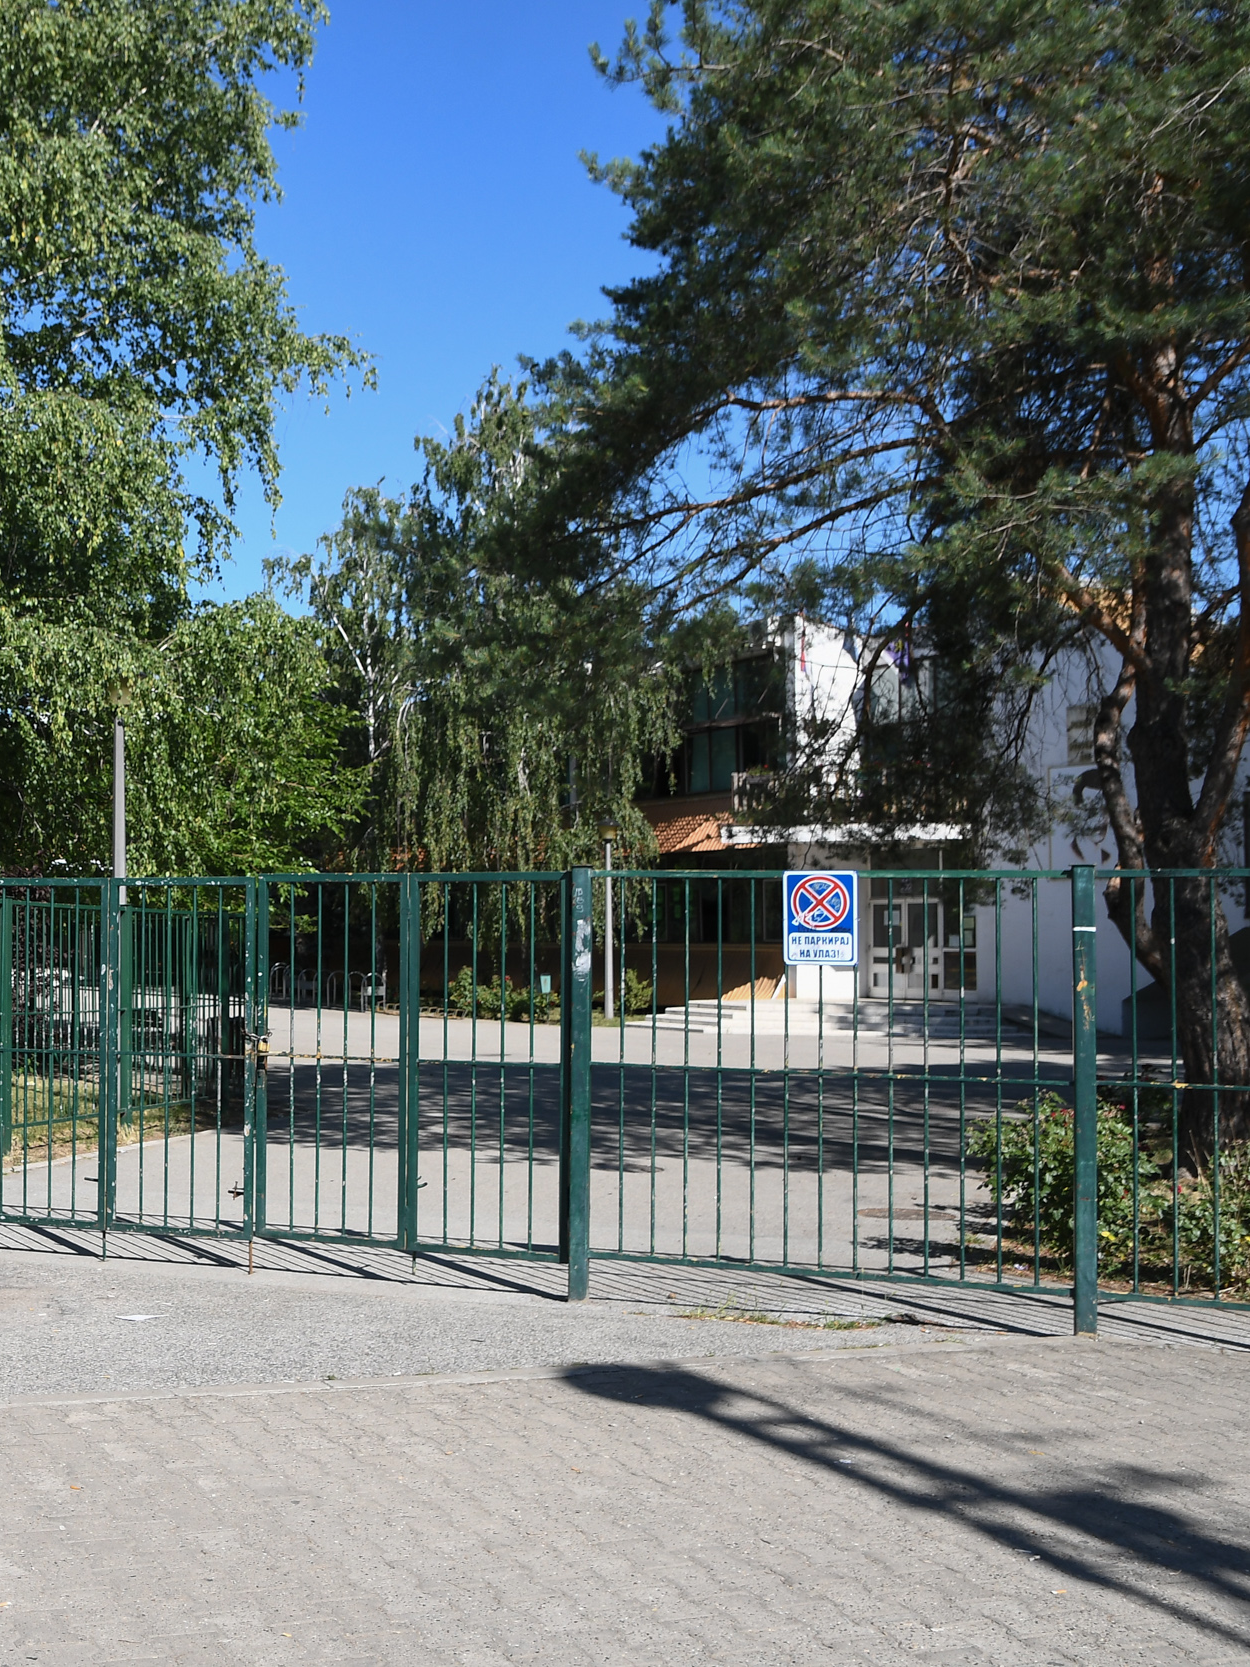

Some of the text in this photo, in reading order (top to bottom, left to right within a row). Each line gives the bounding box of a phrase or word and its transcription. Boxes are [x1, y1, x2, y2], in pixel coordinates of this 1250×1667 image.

[791, 936, 850, 945] НЕ ПАРКИРАЈ
[799, 949, 840, 958] НА УЛАЗ!
